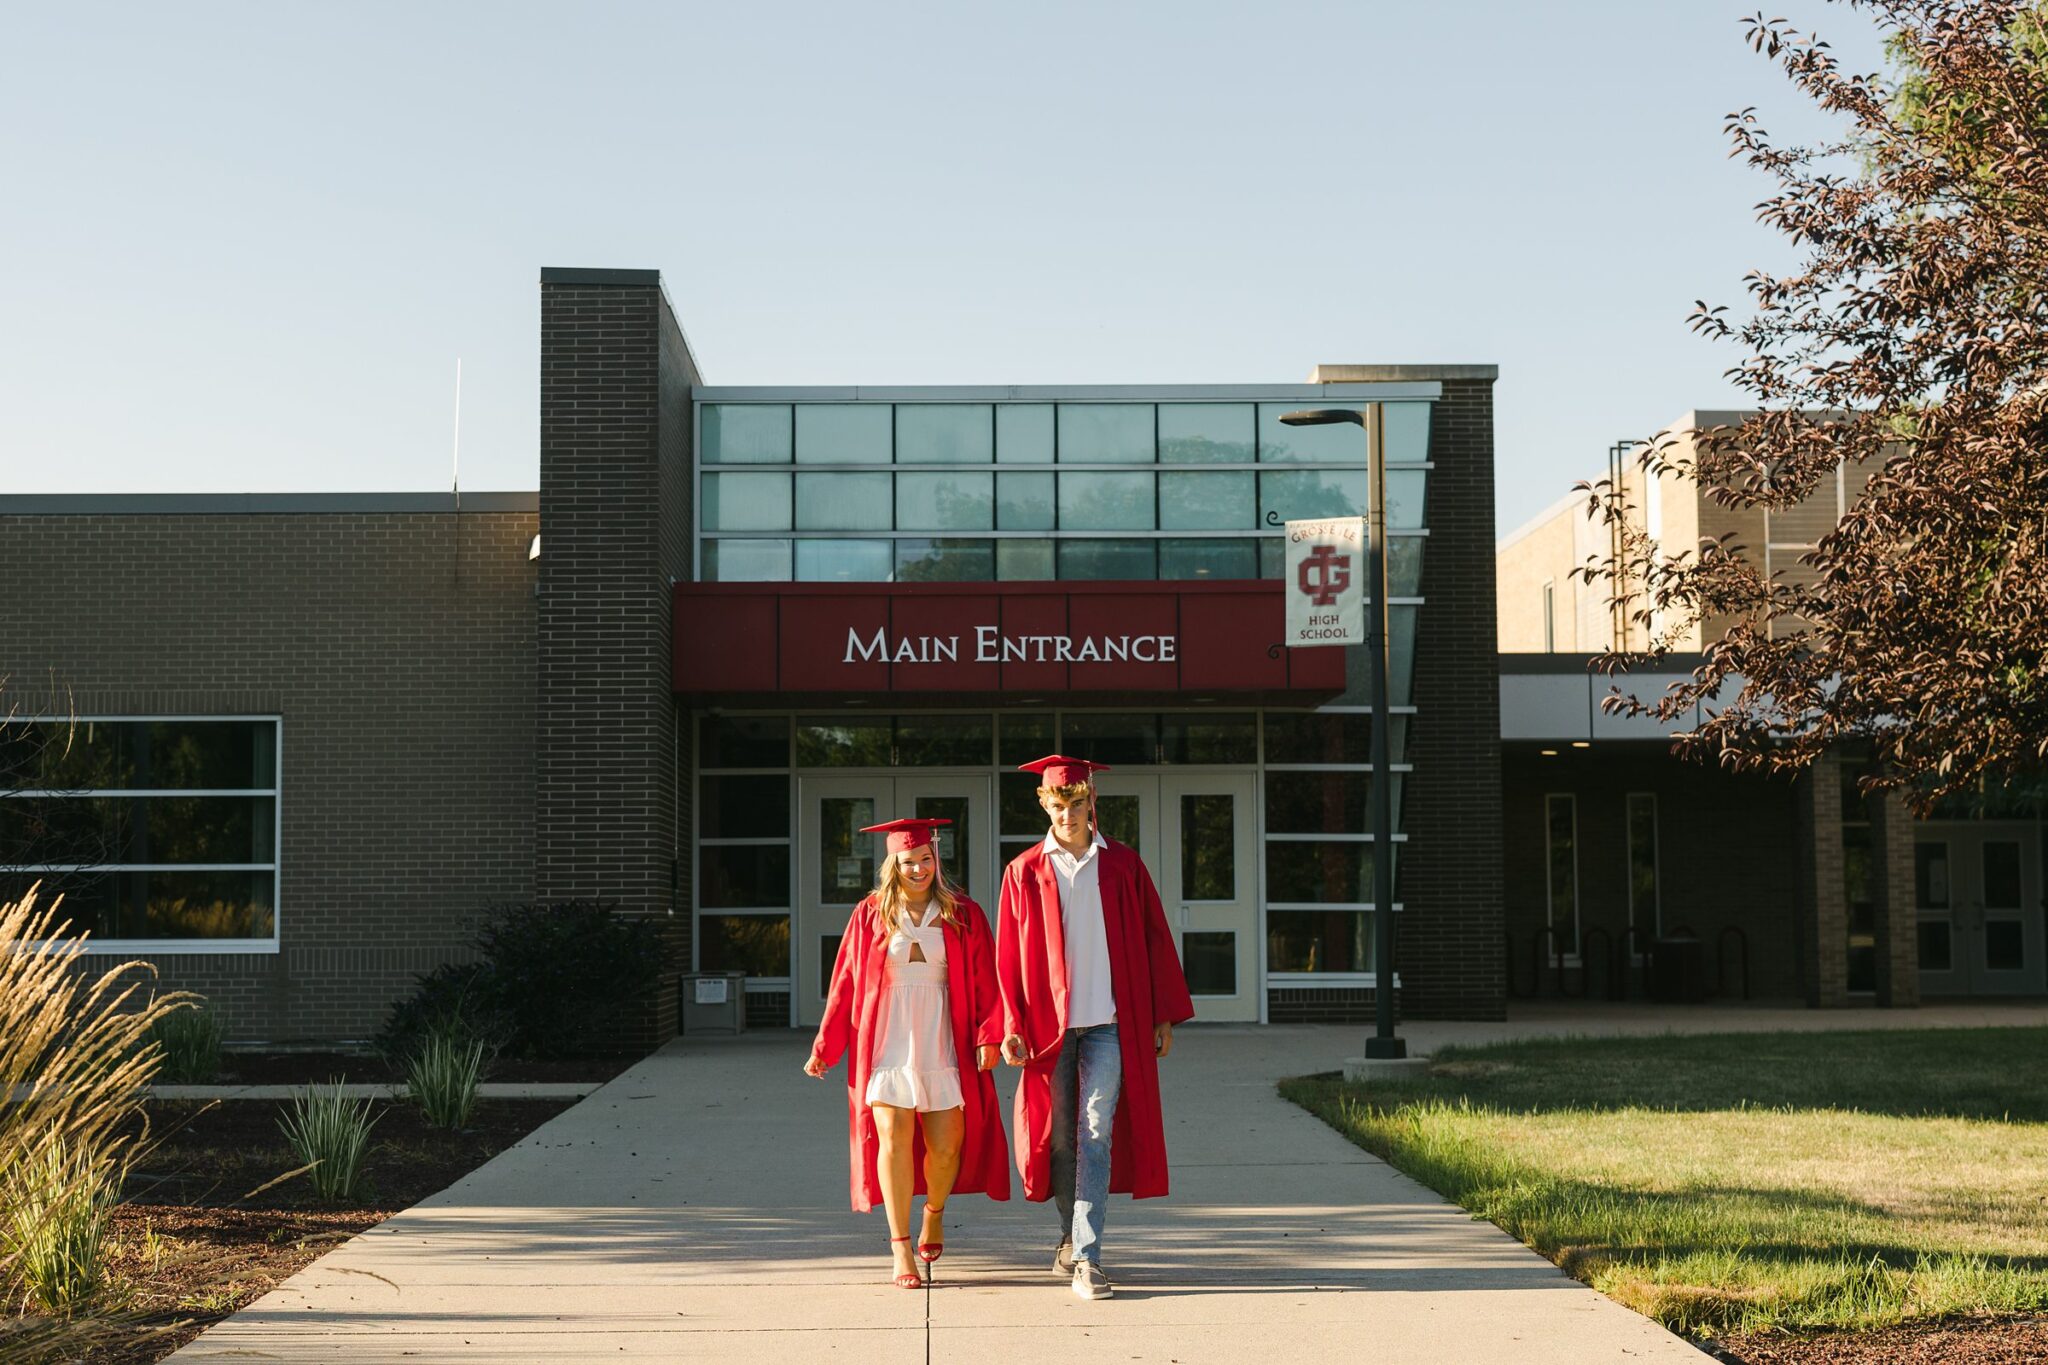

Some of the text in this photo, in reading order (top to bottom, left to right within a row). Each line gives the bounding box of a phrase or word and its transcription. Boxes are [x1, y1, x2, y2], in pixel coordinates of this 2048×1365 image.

[1291, 524, 1335, 543] GROSSE
[1308, 615, 1340, 626] HIGH
[1300, 628, 1349, 640] SCHOOL
[842, 625, 1177, 664] MAIN ENTRANCE
